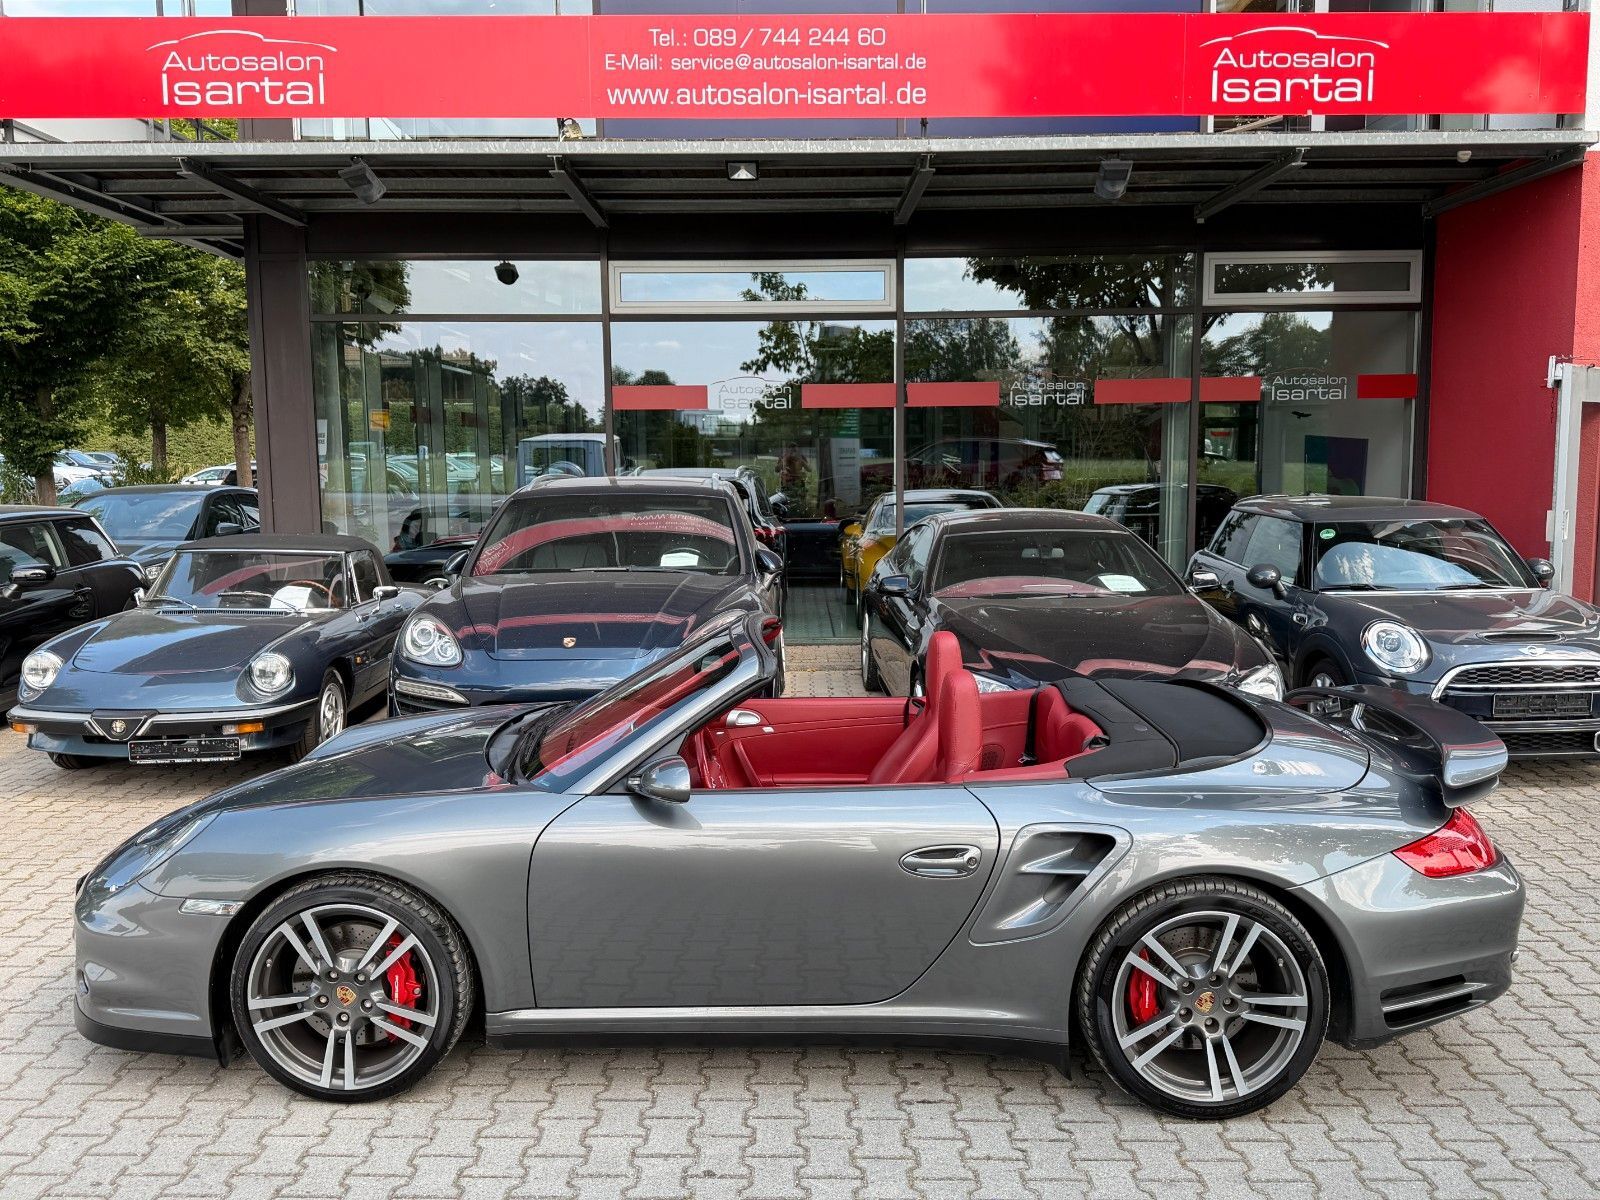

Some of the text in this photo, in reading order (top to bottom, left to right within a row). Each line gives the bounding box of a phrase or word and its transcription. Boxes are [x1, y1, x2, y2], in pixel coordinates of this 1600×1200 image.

[649, 28, 687, 46] Tel.:
[693, 28, 737, 46] 089
[759, 28, 801, 46] 744
[808, 28, 850, 46] 244
[857, 27, 886, 46] 60
[162, 51, 324, 72] Autosalon
[605, 53, 927, 71] E-Mail: service@autosalon-isartal.de
[1213, 47, 1375, 68] Autosalon
[161, 72, 325, 105] Isartal
[606, 81, 927, 106] www.autosalon-isartal.de
[1211, 69, 1374, 102] Isartal
[1272, 375, 1347, 386] Autosalon
[718, 394, 792, 409] Isartal
[1009, 390, 1085, 406] Isartal
[1271, 385, 1347, 401] Isartal
